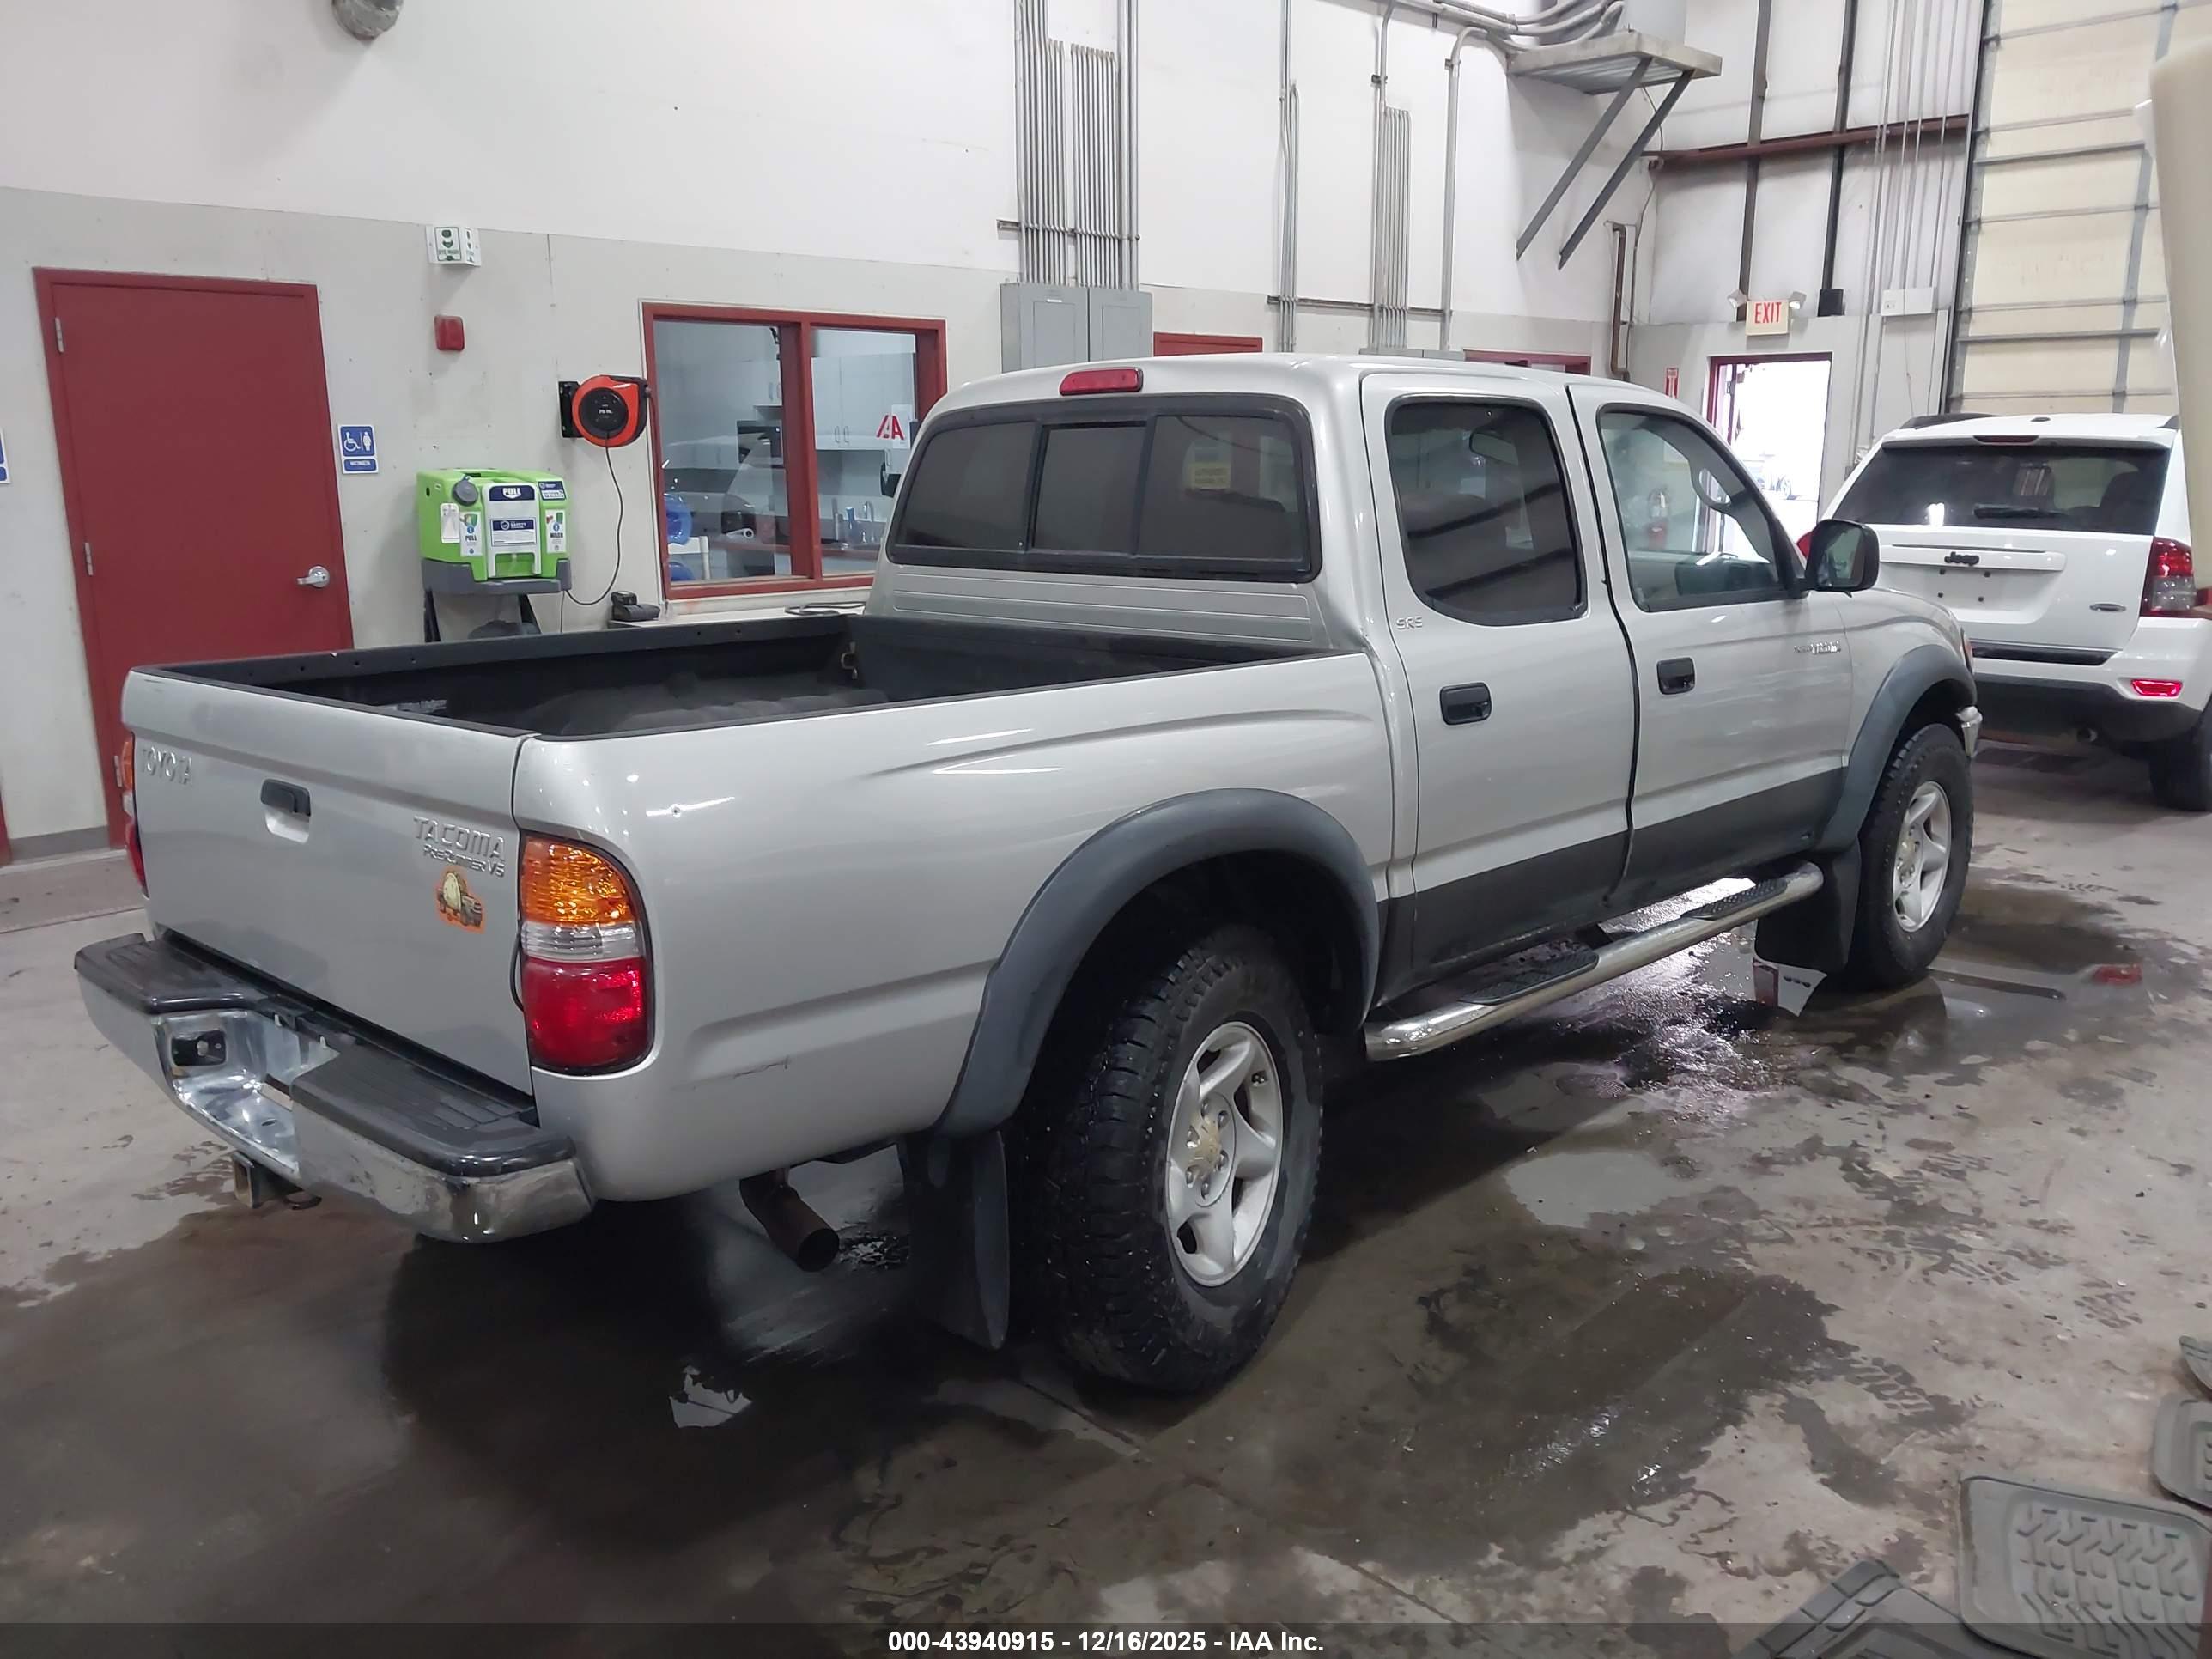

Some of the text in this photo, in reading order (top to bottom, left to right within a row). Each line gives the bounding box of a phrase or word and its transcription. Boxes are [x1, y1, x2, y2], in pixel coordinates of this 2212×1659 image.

[1754, 301, 1782, 324] EXIT
[503, 487, 521, 496] PULL
[413, 816, 506, 859] TACOMA
